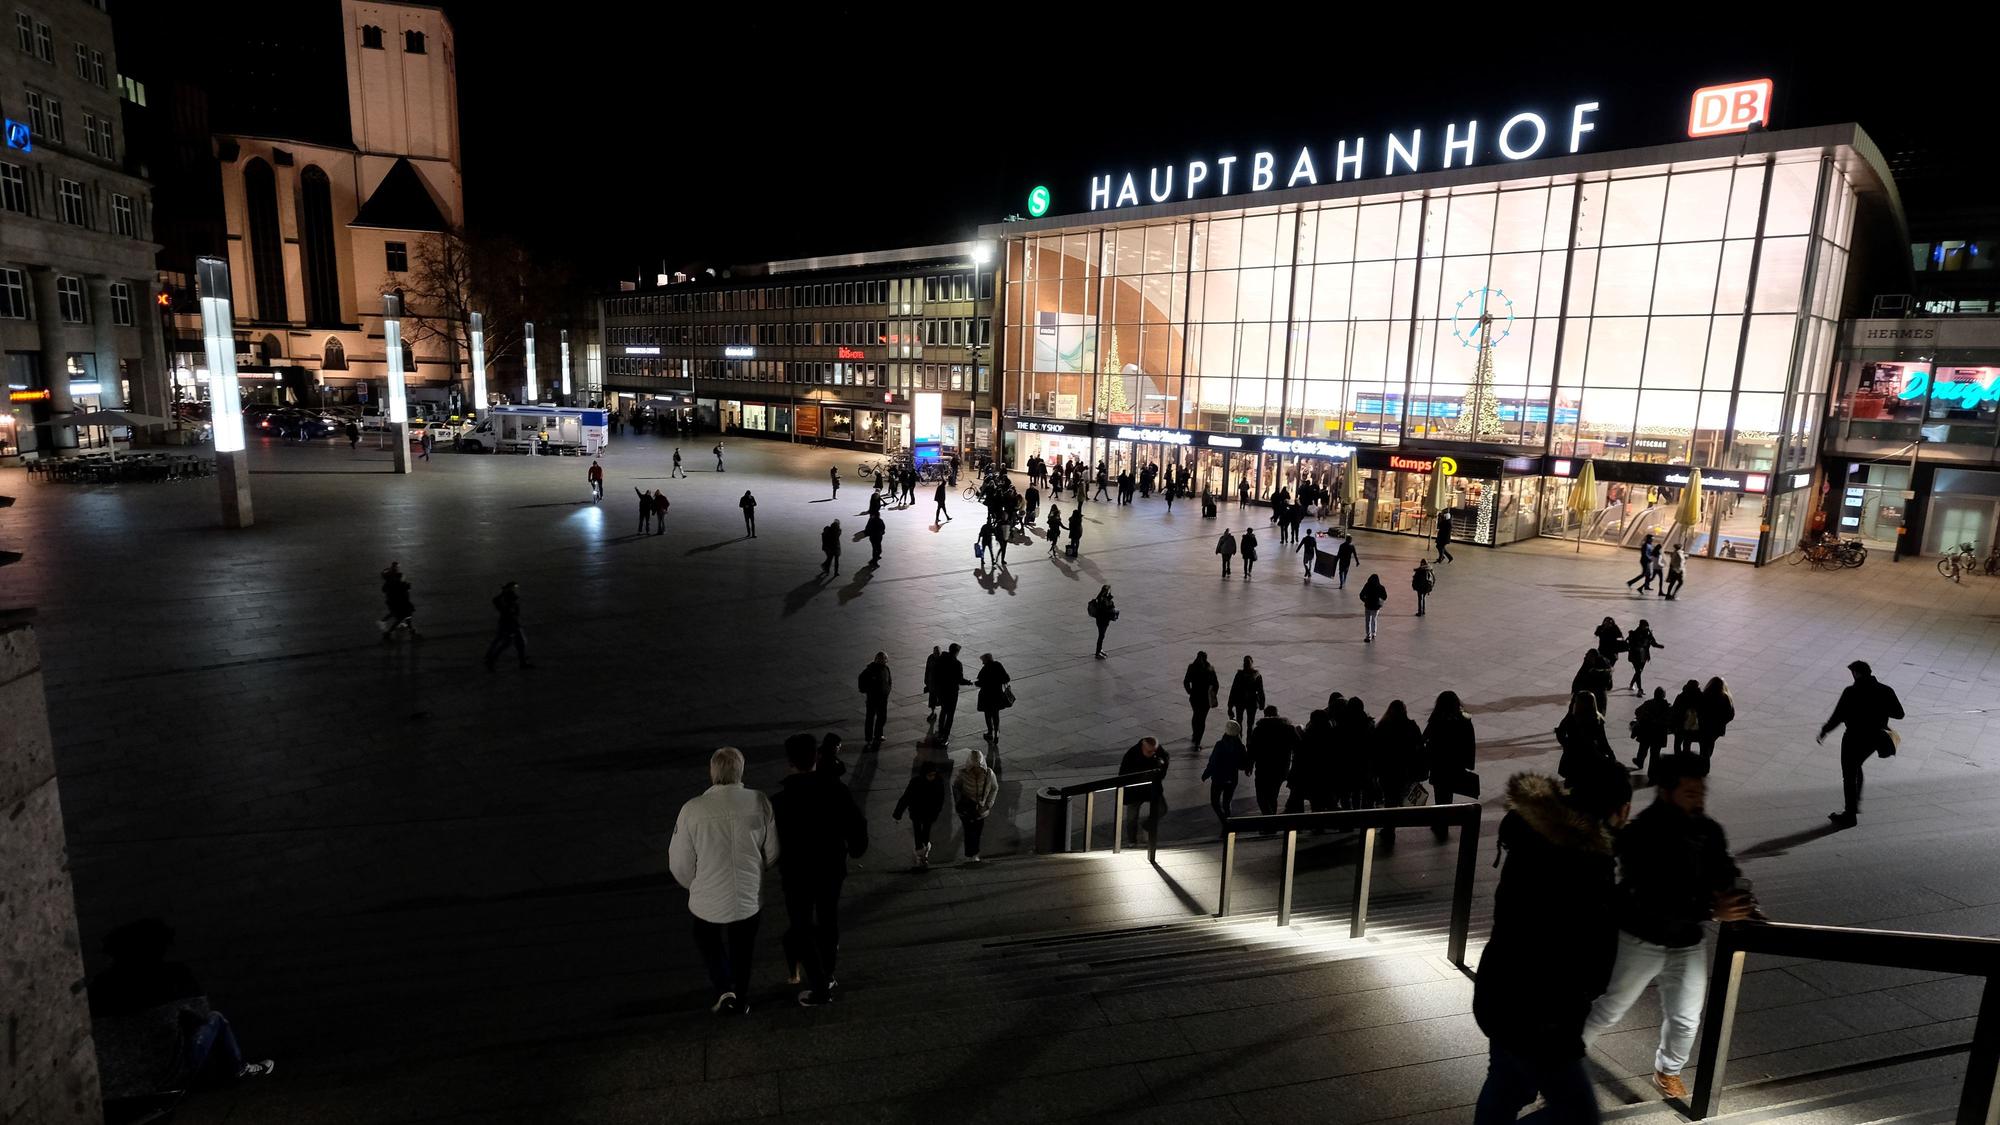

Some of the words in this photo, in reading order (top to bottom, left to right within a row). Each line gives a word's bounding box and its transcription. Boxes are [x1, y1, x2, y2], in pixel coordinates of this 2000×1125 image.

[1699, 89, 1758, 129] DB
[1090, 102, 1599, 211] HAUPTBAHNHOF
[1031, 188, 1047, 214] S
[1867, 329, 1934, 339] HERMES
[838, 347, 850, 359] ibis
[1016, 421, 1029, 430] THE
[1029, 423, 1047, 431] BOY
[1046, 424, 1065, 433] SHOP
[1390, 456, 1432, 472] Kamps
